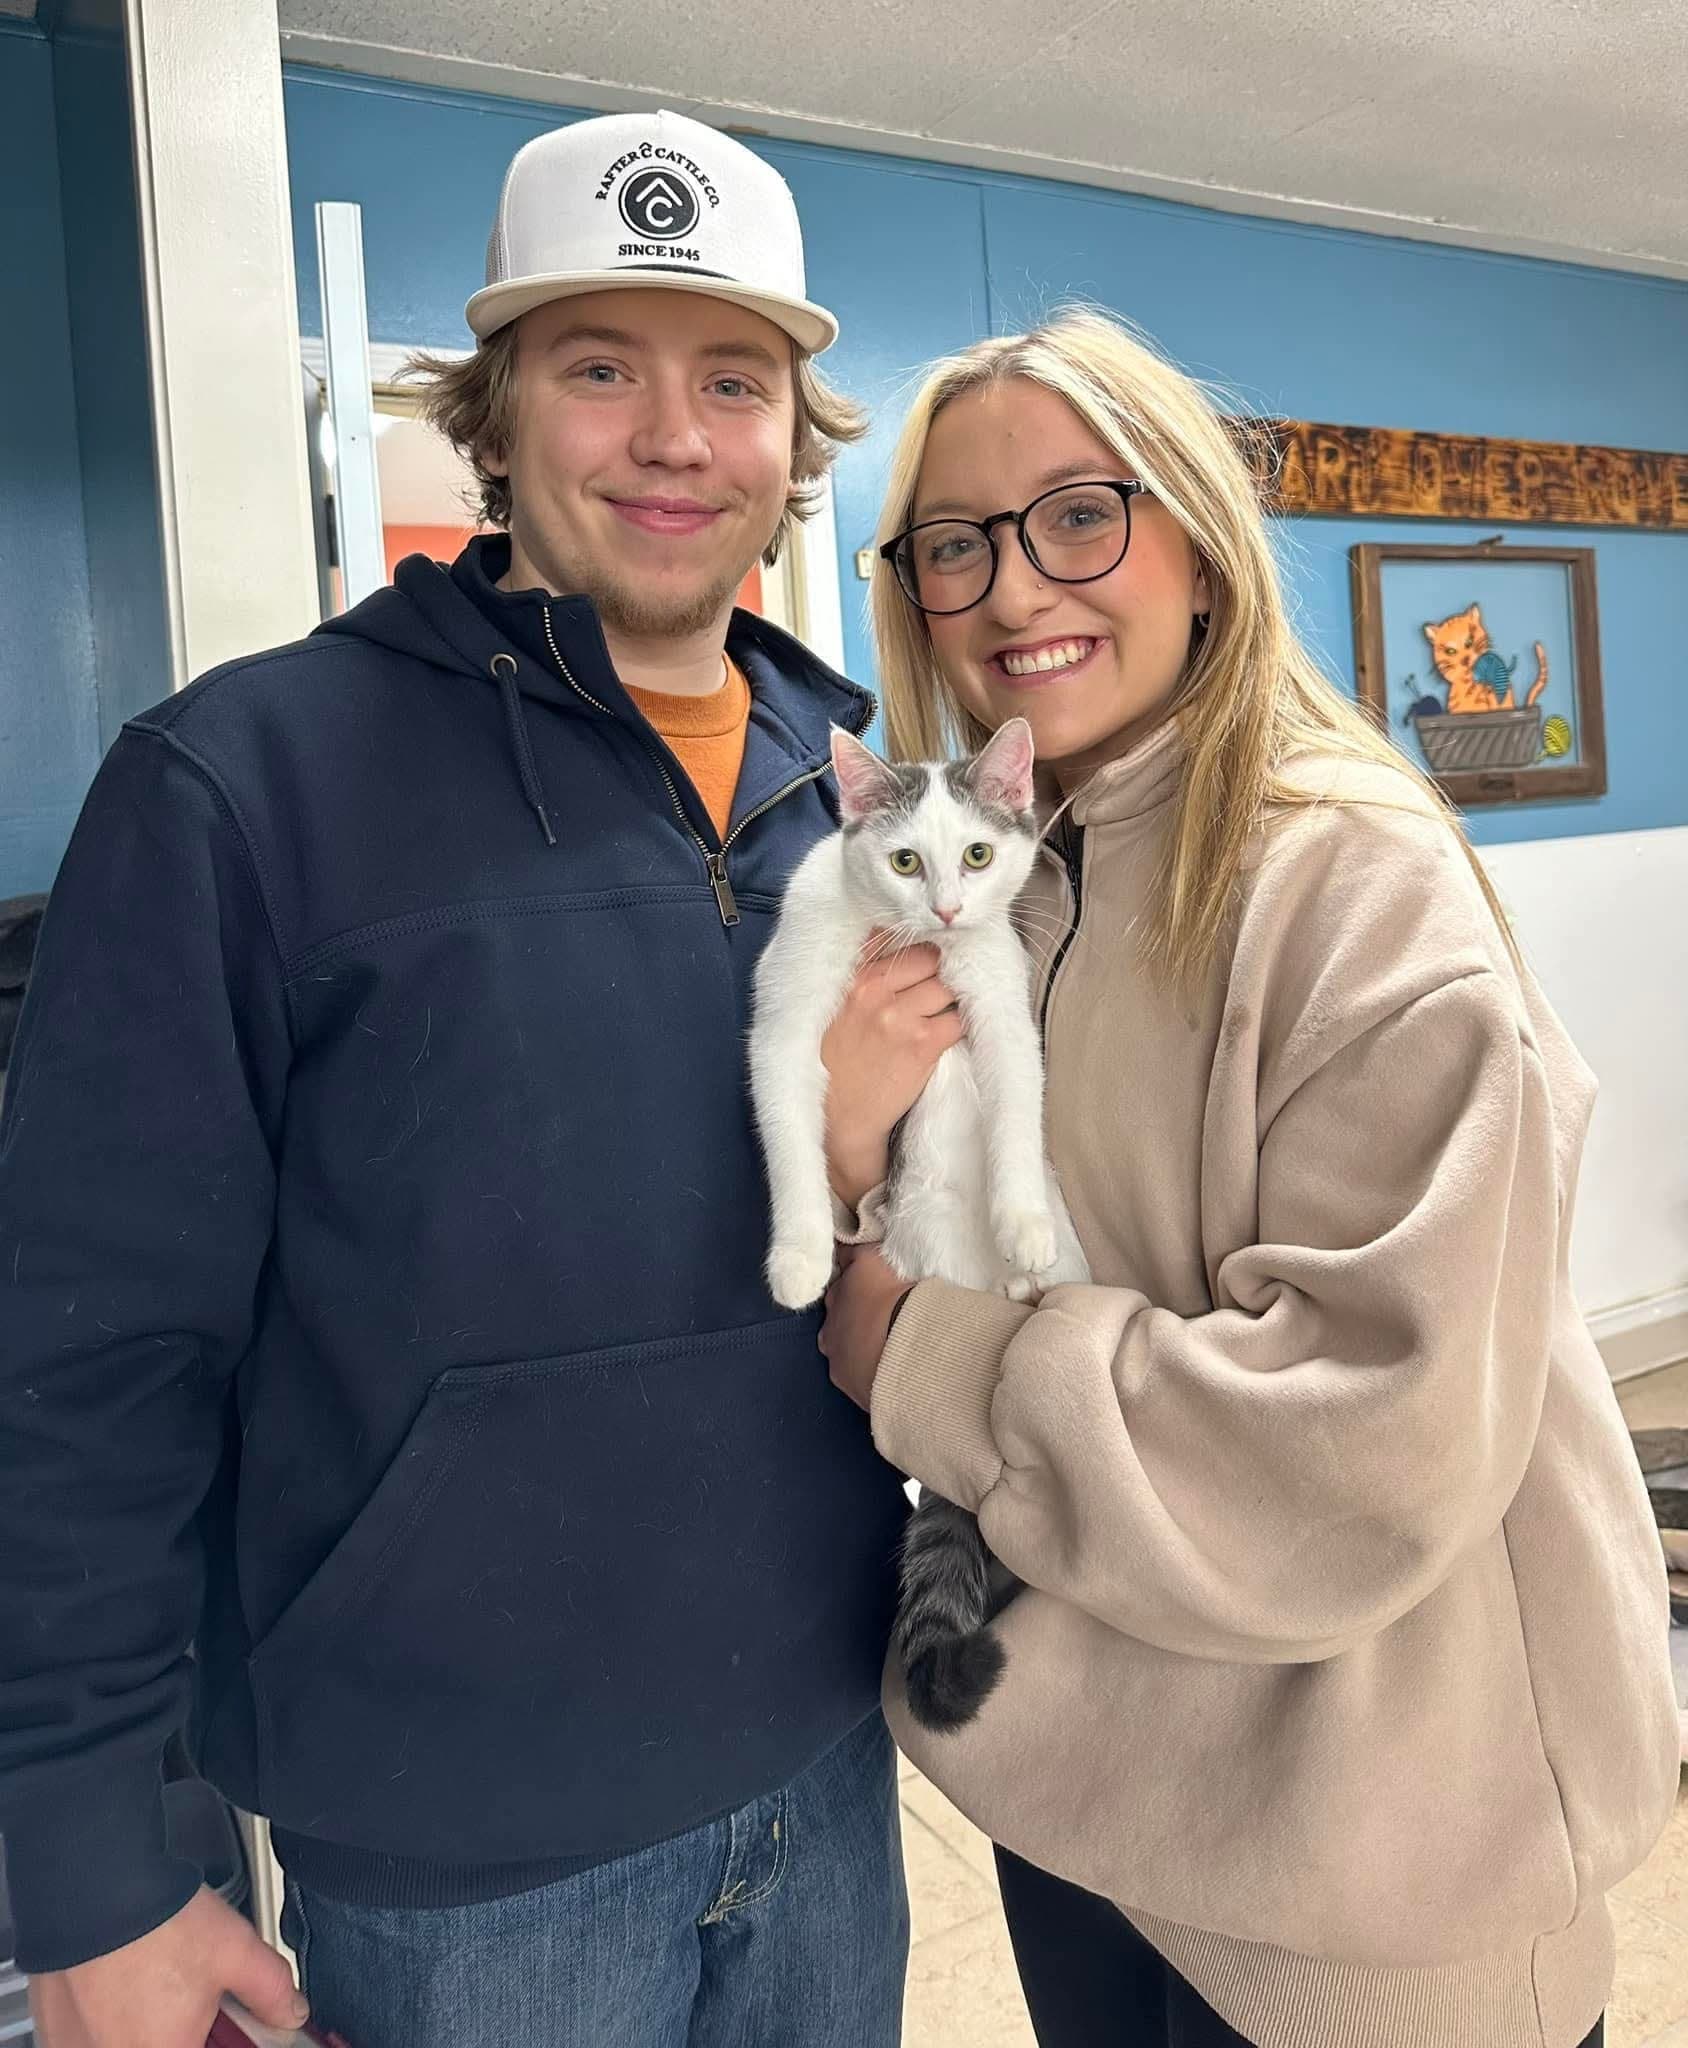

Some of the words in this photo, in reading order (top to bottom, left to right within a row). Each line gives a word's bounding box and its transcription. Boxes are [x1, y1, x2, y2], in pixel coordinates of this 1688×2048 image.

[595, 151, 640, 200] RAFTER
[655, 148, 710, 186] CATTLE
[618, 244, 667, 257] SINCE
[669, 246, 700, 261] 1945
